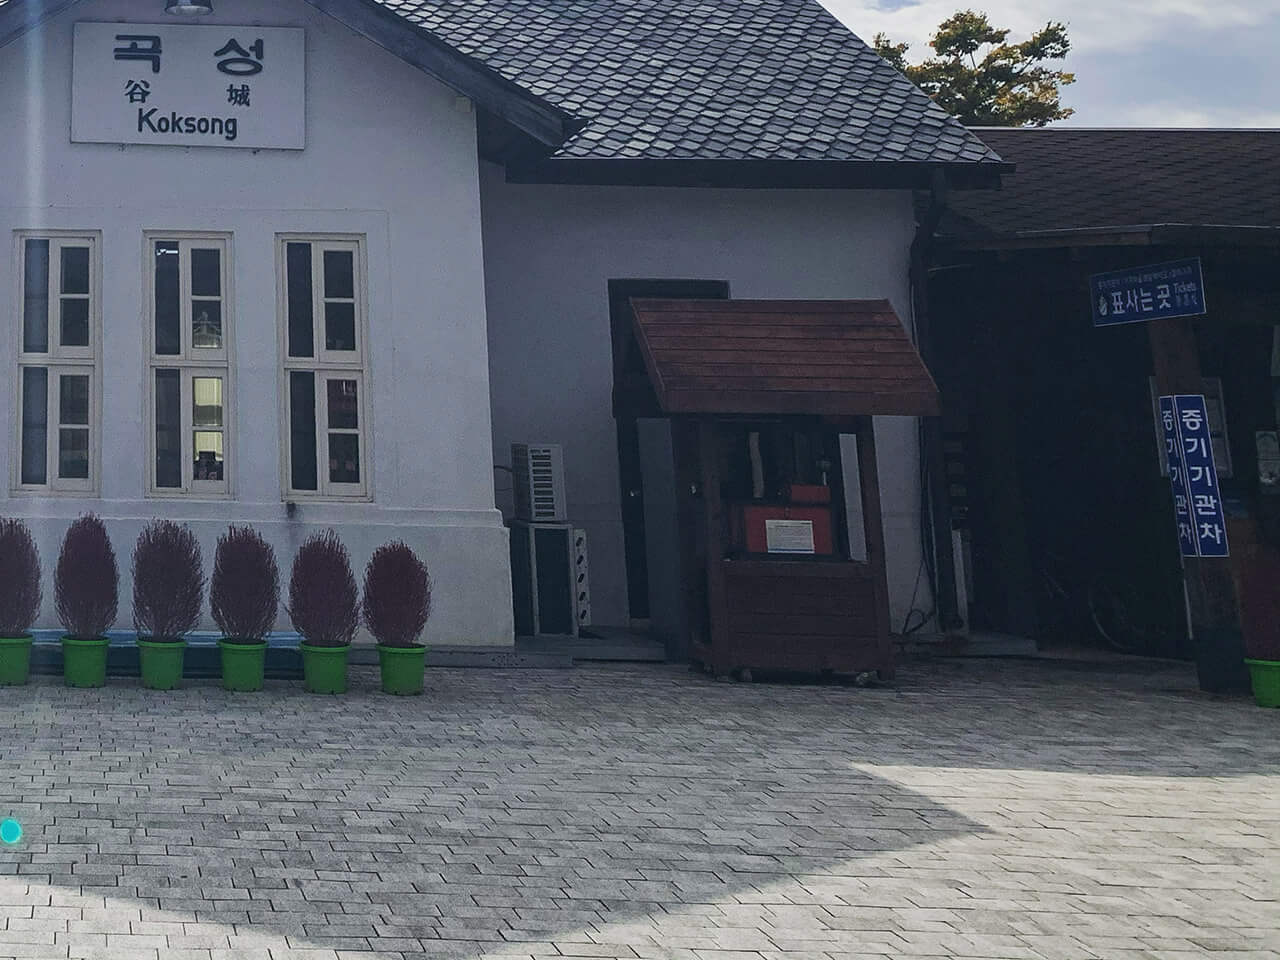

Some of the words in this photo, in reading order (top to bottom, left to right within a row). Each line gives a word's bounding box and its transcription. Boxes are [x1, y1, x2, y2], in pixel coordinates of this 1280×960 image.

[137, 108, 238, 141] Koksong
[1111, 287, 1153, 315] 표사는
[1156, 284, 1172, 310] 곳
[1162, 410, 1193, 545] 증기기관차
[1181, 409, 1223, 545] 증기기관차
